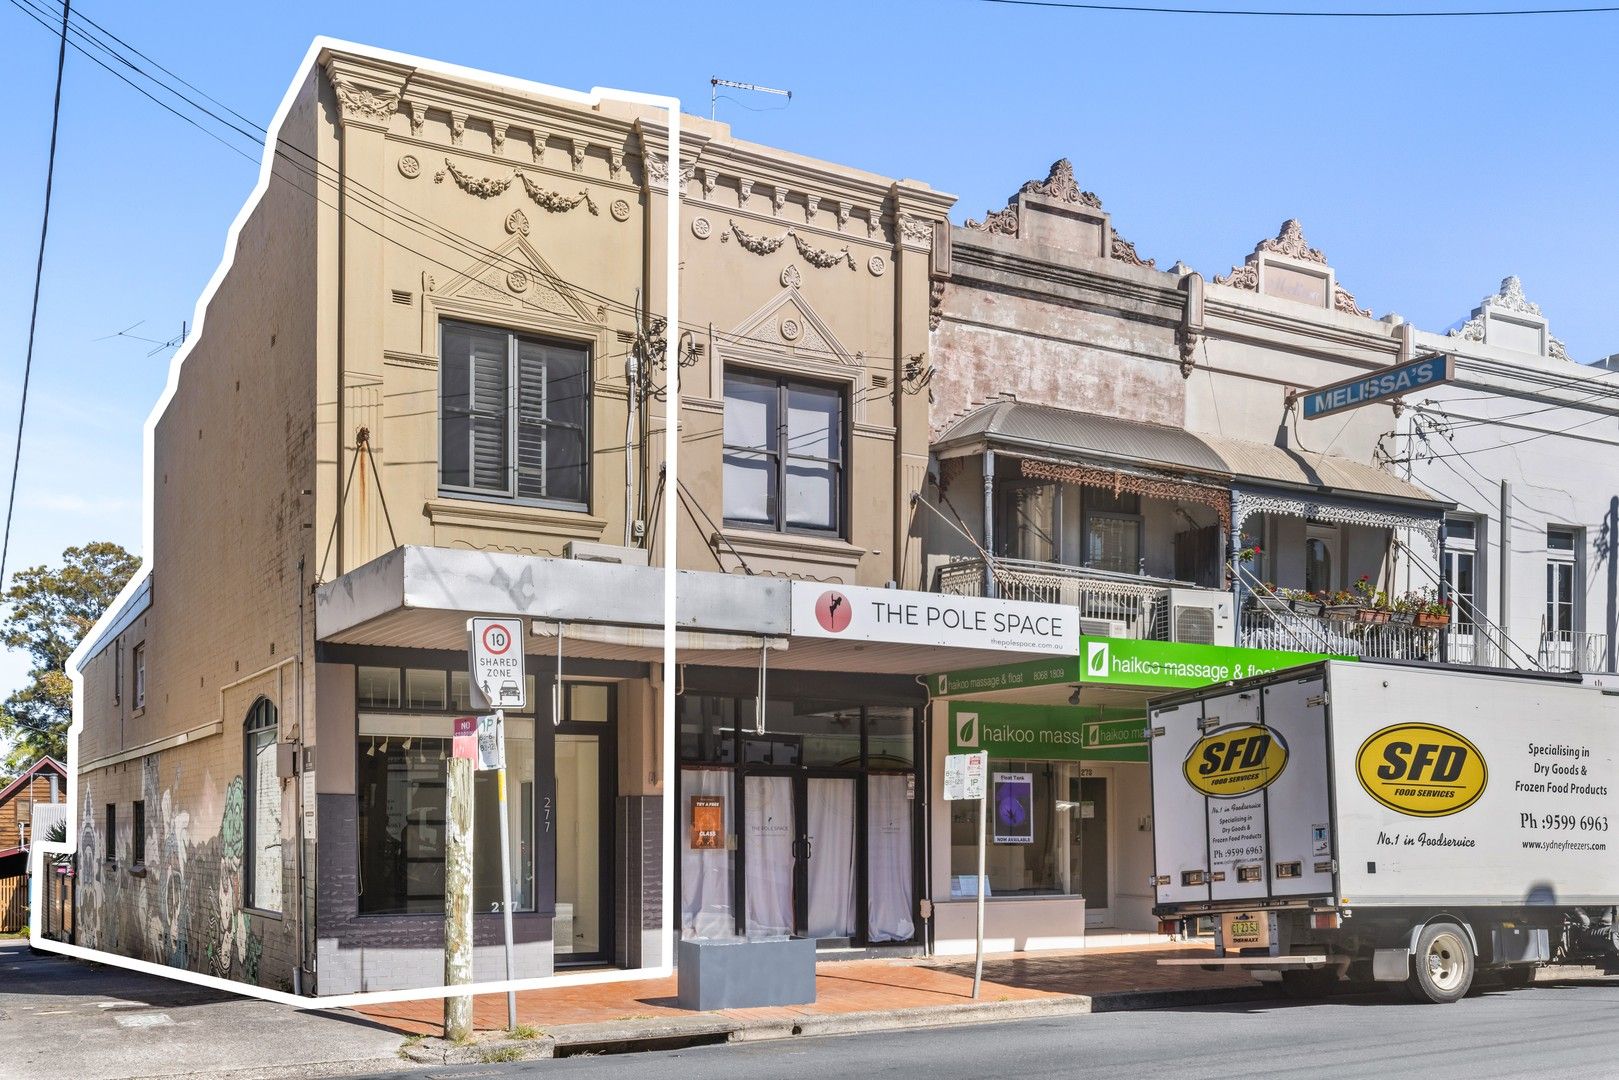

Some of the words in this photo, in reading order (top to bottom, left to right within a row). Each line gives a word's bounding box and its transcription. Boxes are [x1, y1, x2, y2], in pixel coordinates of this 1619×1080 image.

[1314, 363, 1434, 413] MELISSA'S
[871, 601, 919, 626] THE
[926, 606, 987, 632] POLE
[993, 612, 1063, 637] SPACE
[491, 633, 505, 647] 10
[991, 638, 1063, 650] thepolespace.com.au
[480, 658, 518, 667] SHARED
[1112, 655, 1160, 675] haikoo
[1164, 662, 1229, 682] massage
[1232, 664, 1243, 680] &
[487, 669, 512, 678] ZONE
[948, 680, 969, 690] haikoo
[970, 676, 1000, 689] massage
[1001, 673, 1007, 684] &
[1008, 672, 1023, 683] float
[460, 721, 471, 730] NO
[983, 724, 1035, 743] haikoo
[1039, 729, 1083, 744] mass
[1100, 729, 1129, 741] haikoo
[1198, 734, 1272, 775] SFD
[1528, 743, 1580, 760] Specialising
[1581, 746, 1590, 757] in
[1377, 741, 1468, 783] SFD
[1534, 762, 1550, 776] Dry
[1552, 763, 1579, 776] Goods
[1580, 765, 1588, 776] &
[1229, 773, 1260, 784] SERVICES
[1394, 788, 1416, 797] FOOD
[1416, 789, 1455, 798] SERVICES
[1515, 780, 1545, 793] Frozen
[1547, 782, 1569, 794] Food
[1570, 783, 1608, 796] Products
[1219, 816, 1247, 825] Specialising
[1520, 812, 1538, 829] Ph
[1580, 815, 1609, 832] 6963
[1377, 831, 1400, 846] No.1
[1403, 834, 1415, 846] in
[1417, 832, 1476, 847] Foodservice
[1522, 840, 1607, 852] www.sydneyfreezers.com
[1246, 845, 1263, 855] 6963
[491, 901, 518, 913] 27
